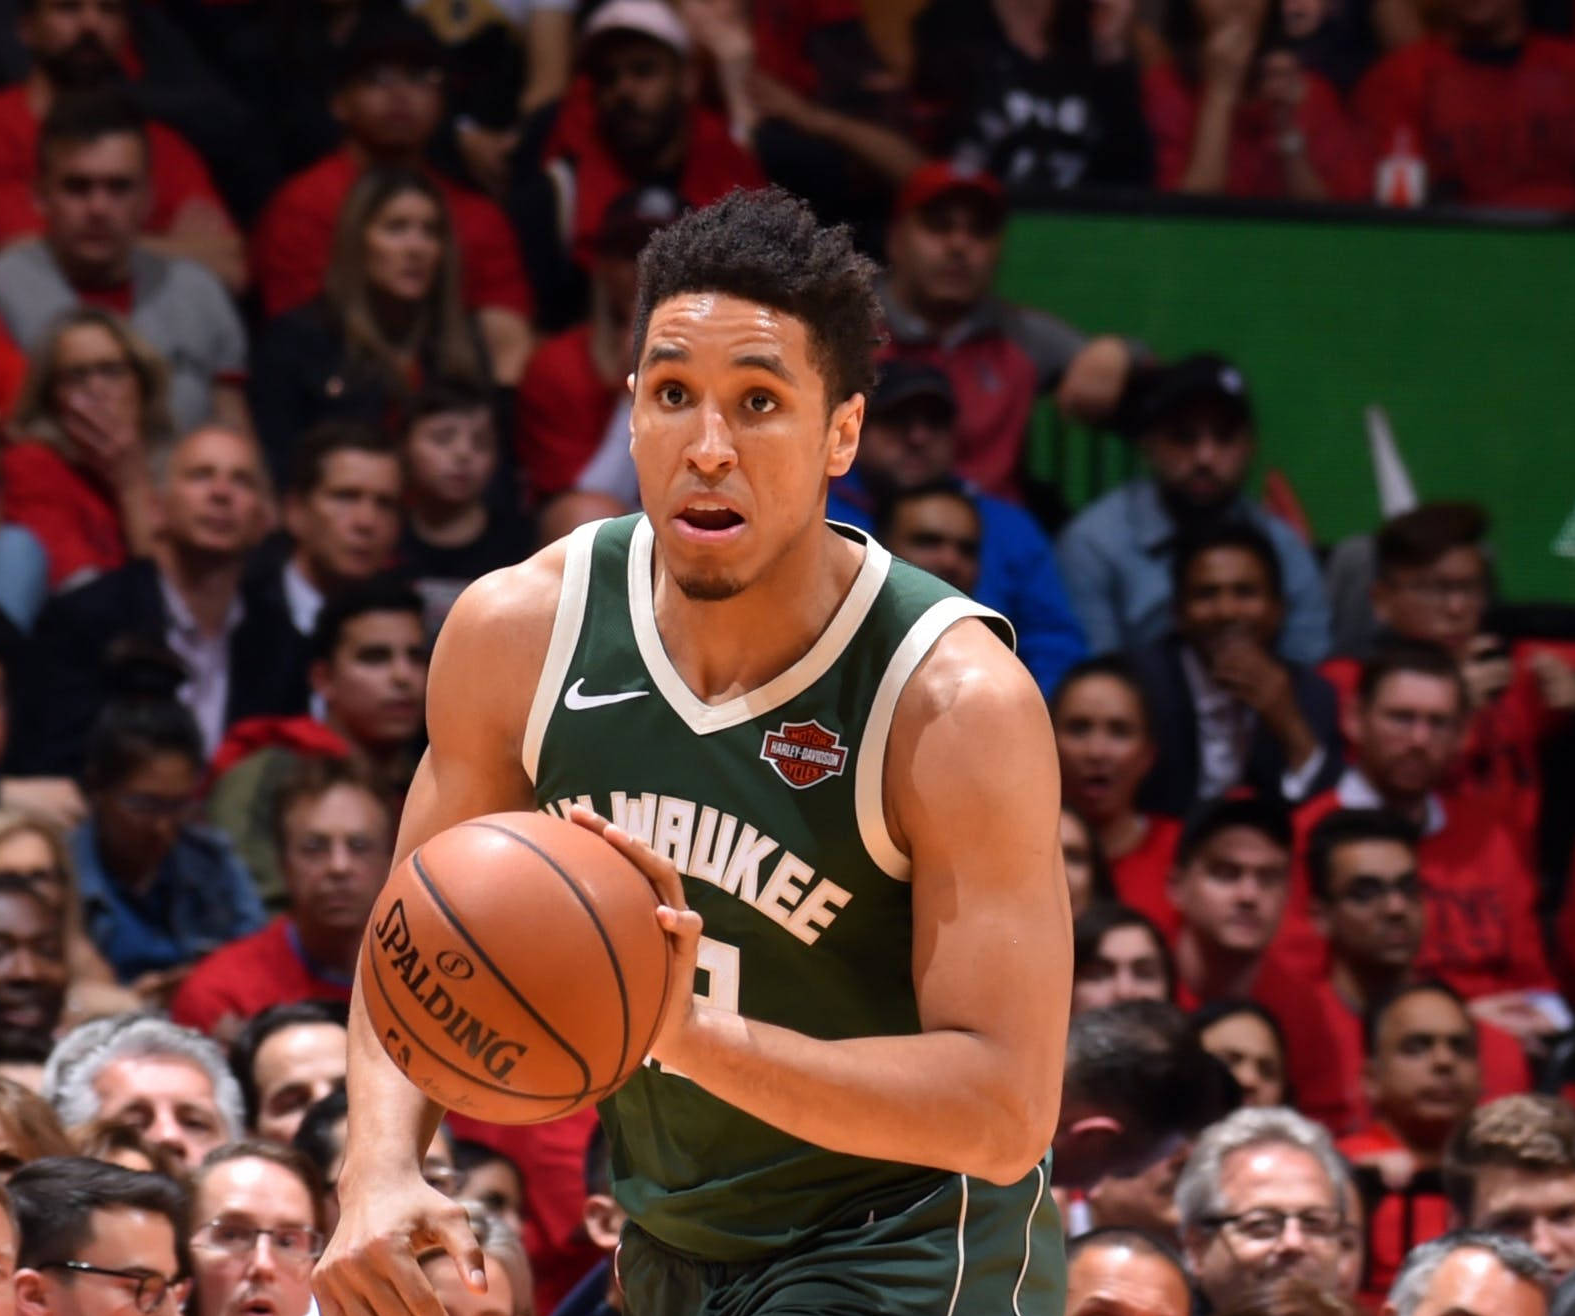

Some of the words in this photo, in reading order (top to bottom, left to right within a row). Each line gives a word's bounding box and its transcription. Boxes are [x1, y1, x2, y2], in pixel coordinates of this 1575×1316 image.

[789, 729, 833, 747] MOTOR
[770, 740, 841, 767] HARLEY-DAVIDSON
[781, 761, 822, 779] CYCLES
[536, 790, 854, 946] WAUKEE
[375, 898, 528, 1081] SPALDING
